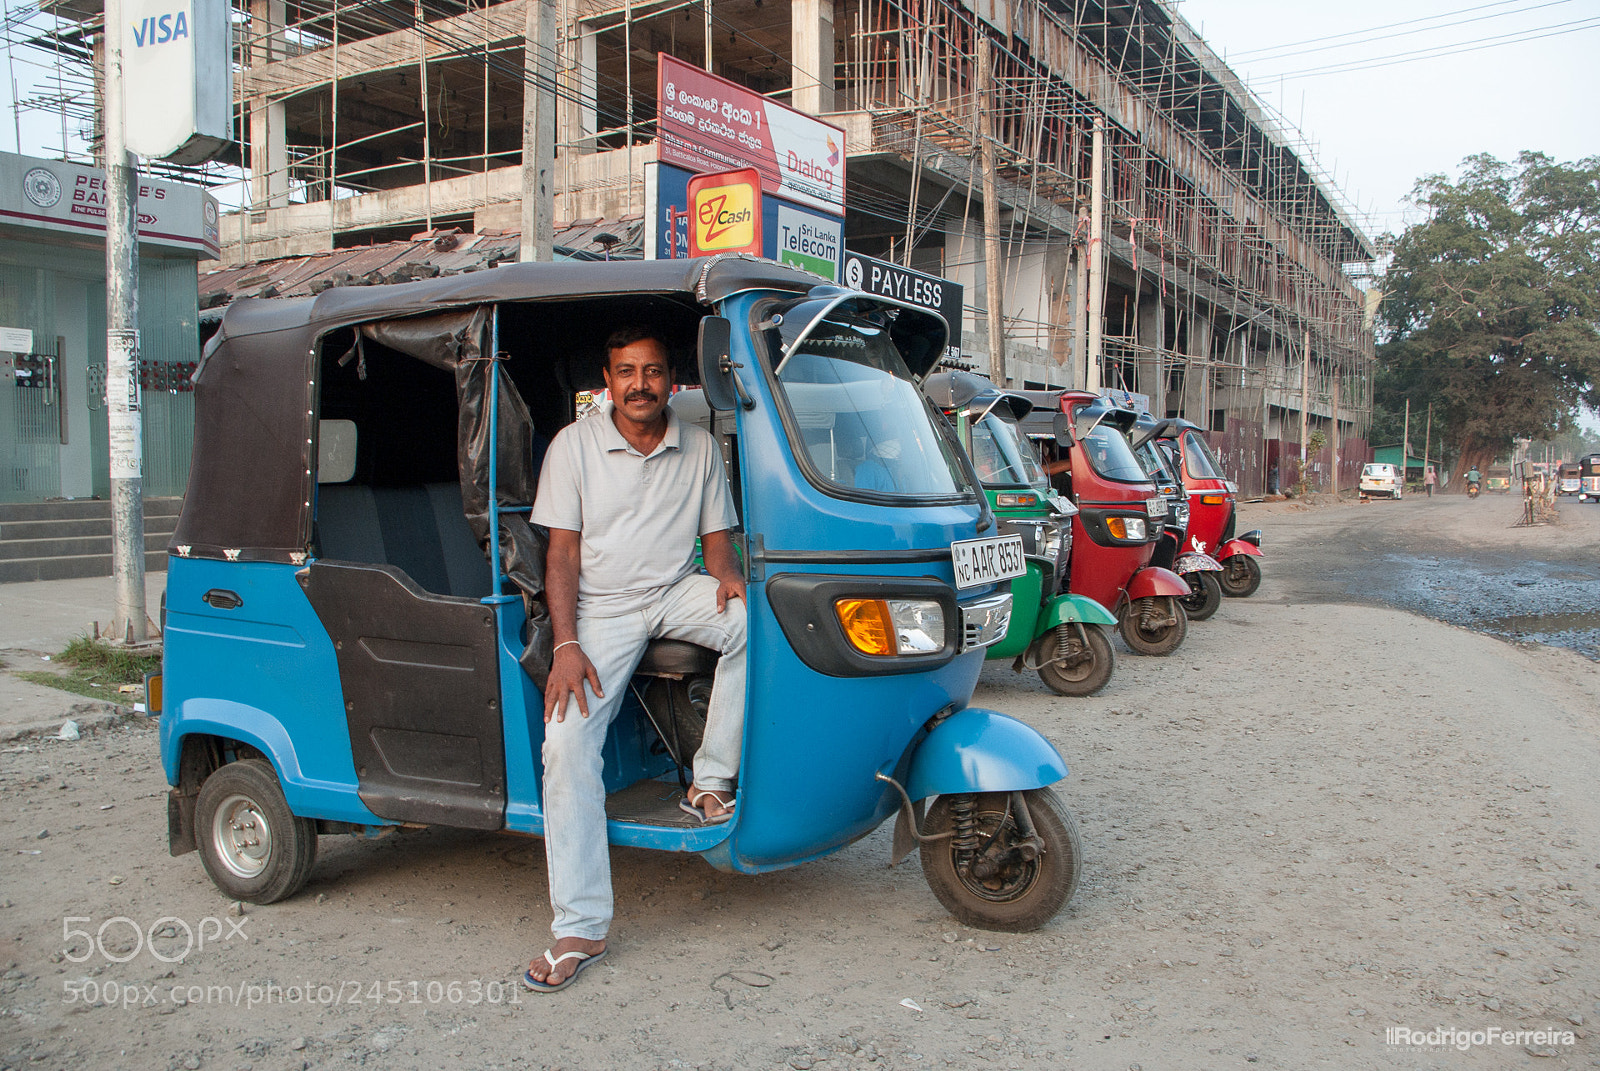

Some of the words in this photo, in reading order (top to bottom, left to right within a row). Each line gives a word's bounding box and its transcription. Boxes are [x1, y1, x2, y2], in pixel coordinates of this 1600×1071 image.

[130, 11, 188, 48] VISA
[721, 102, 752, 126] අංක
[75, 174, 167, 200] PEE'S
[787, 149, 834, 190] Dialog
[717, 207, 752, 225] Cash
[801, 223, 813, 237] Sri
[814, 227, 837, 244] Lanka
[782, 225, 836, 260] Telecom
[871, 266, 942, 308] PAYLESS
[957, 563, 971, 583] NC
[998, 540, 1024, 574] 8537
